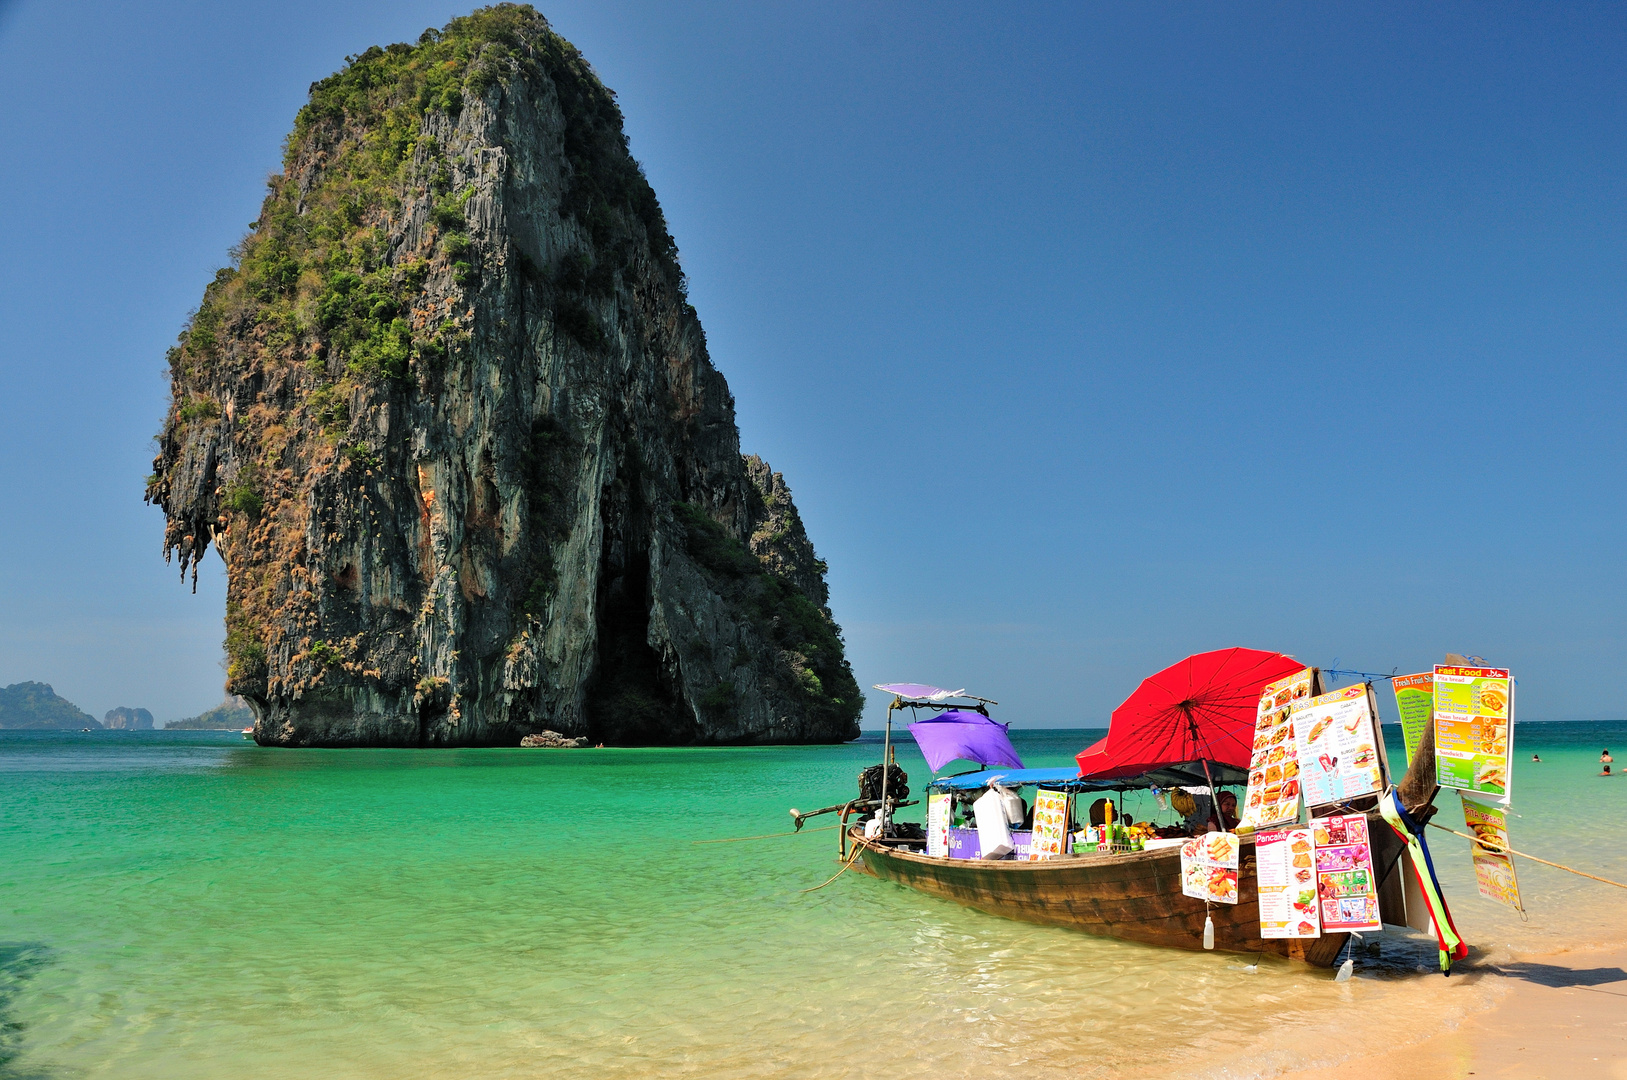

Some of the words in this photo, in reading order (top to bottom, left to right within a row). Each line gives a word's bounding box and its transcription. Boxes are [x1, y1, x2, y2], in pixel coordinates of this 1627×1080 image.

[1459, 668, 1482, 676] Food
[1395, 679, 1410, 687] Fresh
[1411, 677, 1423, 685] Fruit
[1293, 699, 1315, 712] FAST
[1318, 691, 1342, 704] FOOD
[1341, 747, 1356, 755] BURGER
[1465, 807, 1479, 819] PITA
[1481, 812, 1503, 826] BREAD
[1256, 832, 1287, 843] Pancake
